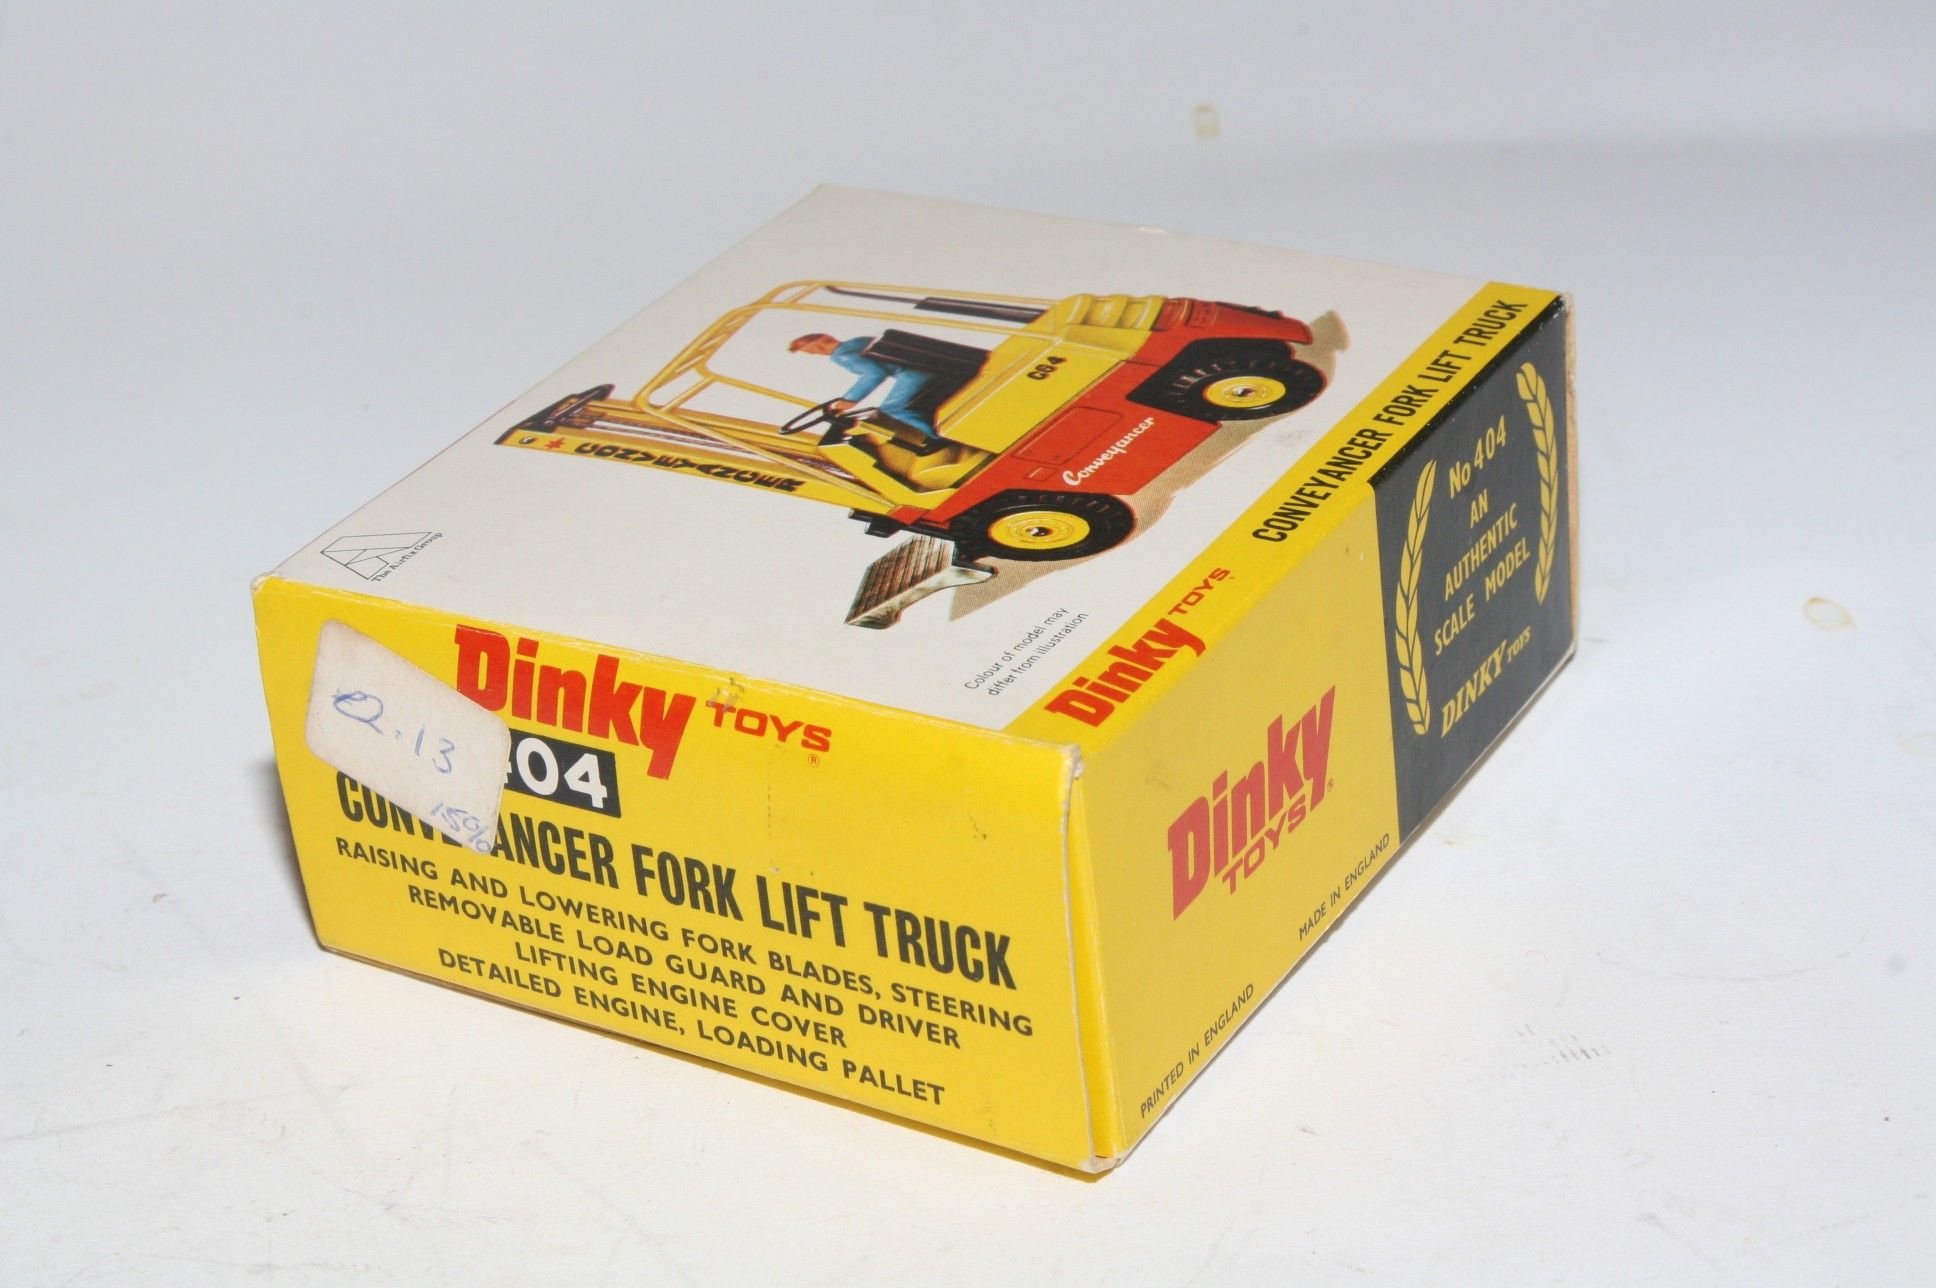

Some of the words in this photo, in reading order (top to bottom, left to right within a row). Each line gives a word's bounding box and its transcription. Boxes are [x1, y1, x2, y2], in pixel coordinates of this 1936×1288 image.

[574, 442, 806, 492] CONVEYANCER
[1062, 415, 1156, 487] Conveyancer
[1252, 424, 1392, 543] CONVEYANCER
[1373, 384, 1430, 427] FORK
[1417, 350, 1472, 383] LIFT
[1453, 299, 1528, 347] TRUCK
[1450, 461, 1471, 499] No
[1474, 415, 1507, 470] 404
[1444, 503, 1518, 602] AUTHENTIC
[1470, 488, 1488, 529] AN
[964, 661, 1002, 691] Colour
[1000, 650, 1016, 664] of
[1013, 624, 1047, 653] model
[1043, 607, 1071, 627] may
[1044, 618, 1206, 728] Dinky
[1168, 567, 1232, 616] TOYS
[1434, 597, 1475, 656] SCALE
[1485, 536, 1531, 602] MODEL
[455, 624, 697, 780] Dinky
[706, 700, 832, 753] TOYS
[988, 676, 1018, 697] differ
[1014, 654, 1042, 678] from
[1038, 611, 1090, 658] illustration
[1440, 638, 1507, 738] DINKY
[1506, 626, 1532, 663] TOYS
[502, 736, 608, 809] 04
[1167, 685, 1336, 921] Dinky
[1222, 794, 1306, 895] TOYS
[1299, 901, 1327, 941] MADE
[1330, 886, 1341, 907] IN
[1344, 833, 1390, 891] ENGLAND
[335, 836, 439, 881] RAISING
[450, 868, 508, 899] AND
[519, 885, 669, 942] LOWERING
[681, 928, 758, 965] FORK
[768, 952, 882, 1000] BLADES,
[891, 983, 1034, 1037] STEERING
[408, 884, 565, 944] REMOVABLE
[576, 929, 653, 966] LOAD
[665, 954, 767, 996] GUARD
[780, 984, 845, 1017] AND
[858, 1003, 962, 1050] DRIVER
[631, 843, 745, 922] FORK
[756, 875, 848, 949] LIFT
[864, 902, 1017, 991] TRUCK
[438, 948, 562, 998] DETAILED
[573, 986, 686, 1036] ENGINE,
[697, 1019, 830, 1073] LOADING
[842, 1058, 946, 1106] PALLET
[514, 941, 619, 986] LIFTING
[631, 973, 738, 1019] ENGINE
[750, 1006, 848, 1048] COVER
[1140, 1061, 1184, 1119] PRINTED
[1187, 1041, 1200, 1065] IN
[1203, 983, 1254, 1047] ENGLAND
